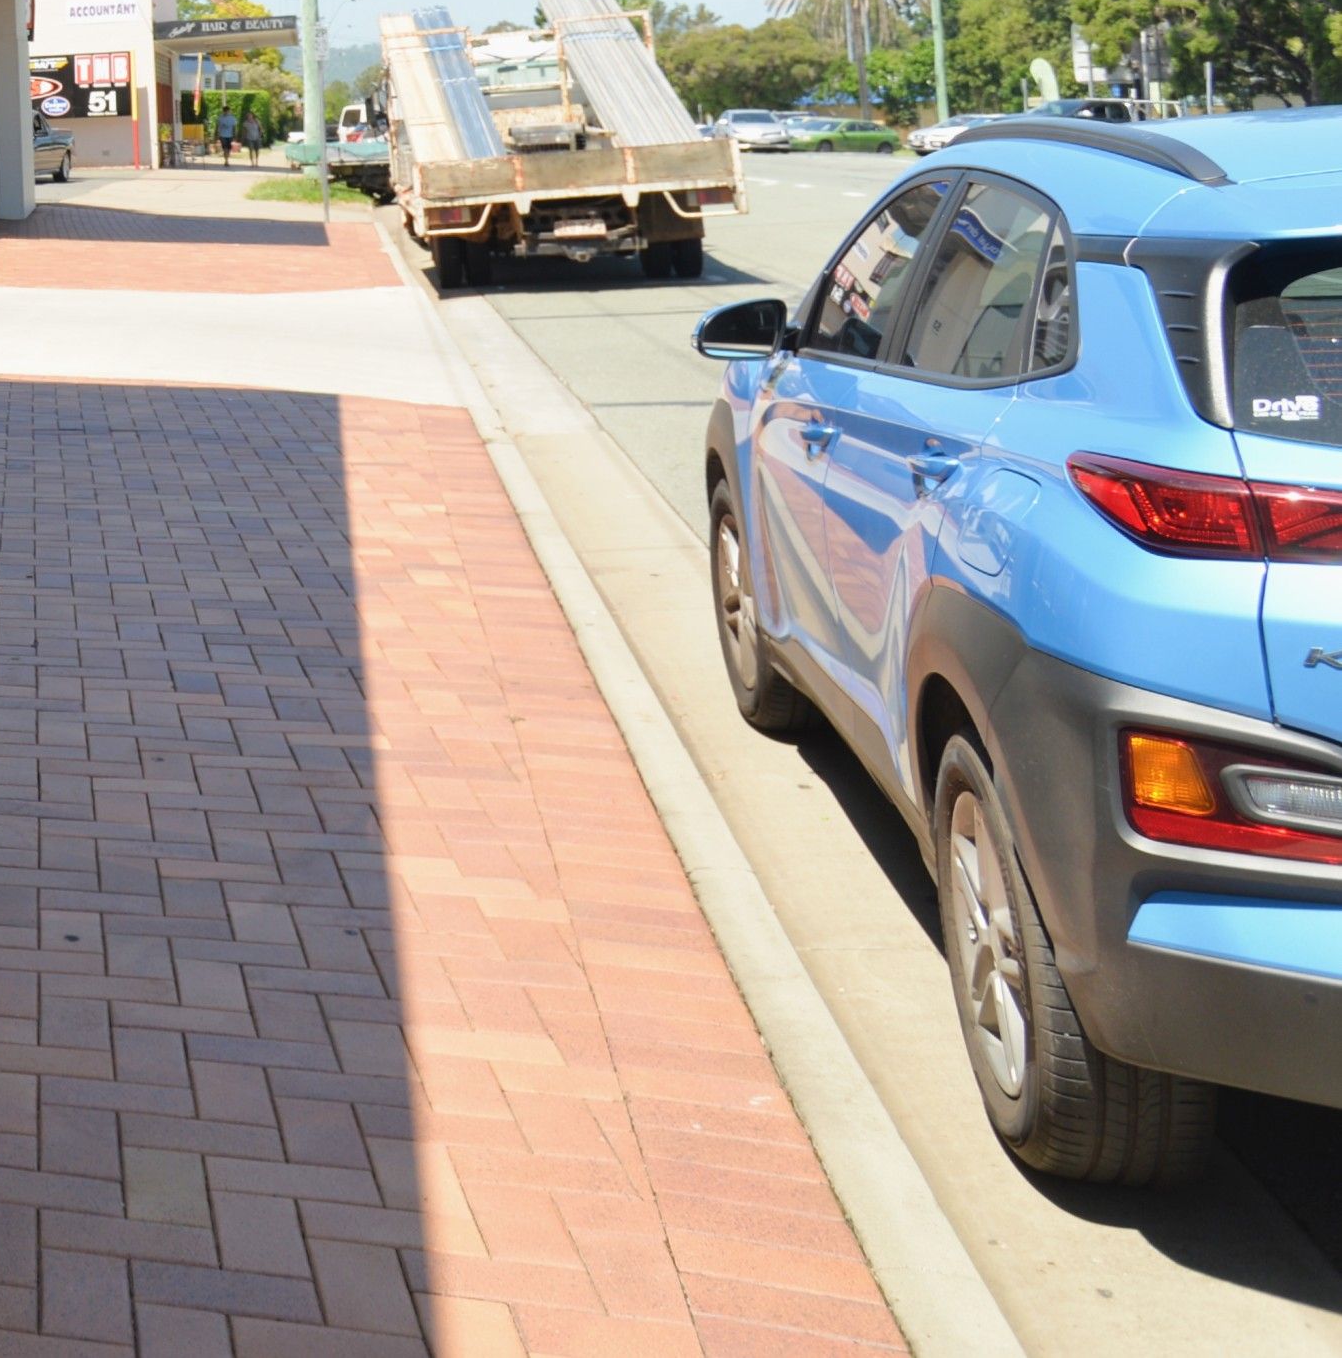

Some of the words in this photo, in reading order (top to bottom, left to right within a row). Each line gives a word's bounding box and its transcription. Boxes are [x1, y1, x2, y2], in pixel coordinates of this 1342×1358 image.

[70, 3, 136, 18] ACCOUNTANT
[201, 21, 228, 32] HAIR
[245, 17, 285, 30] BEAUTY
[88, 90, 118, 113] 51
